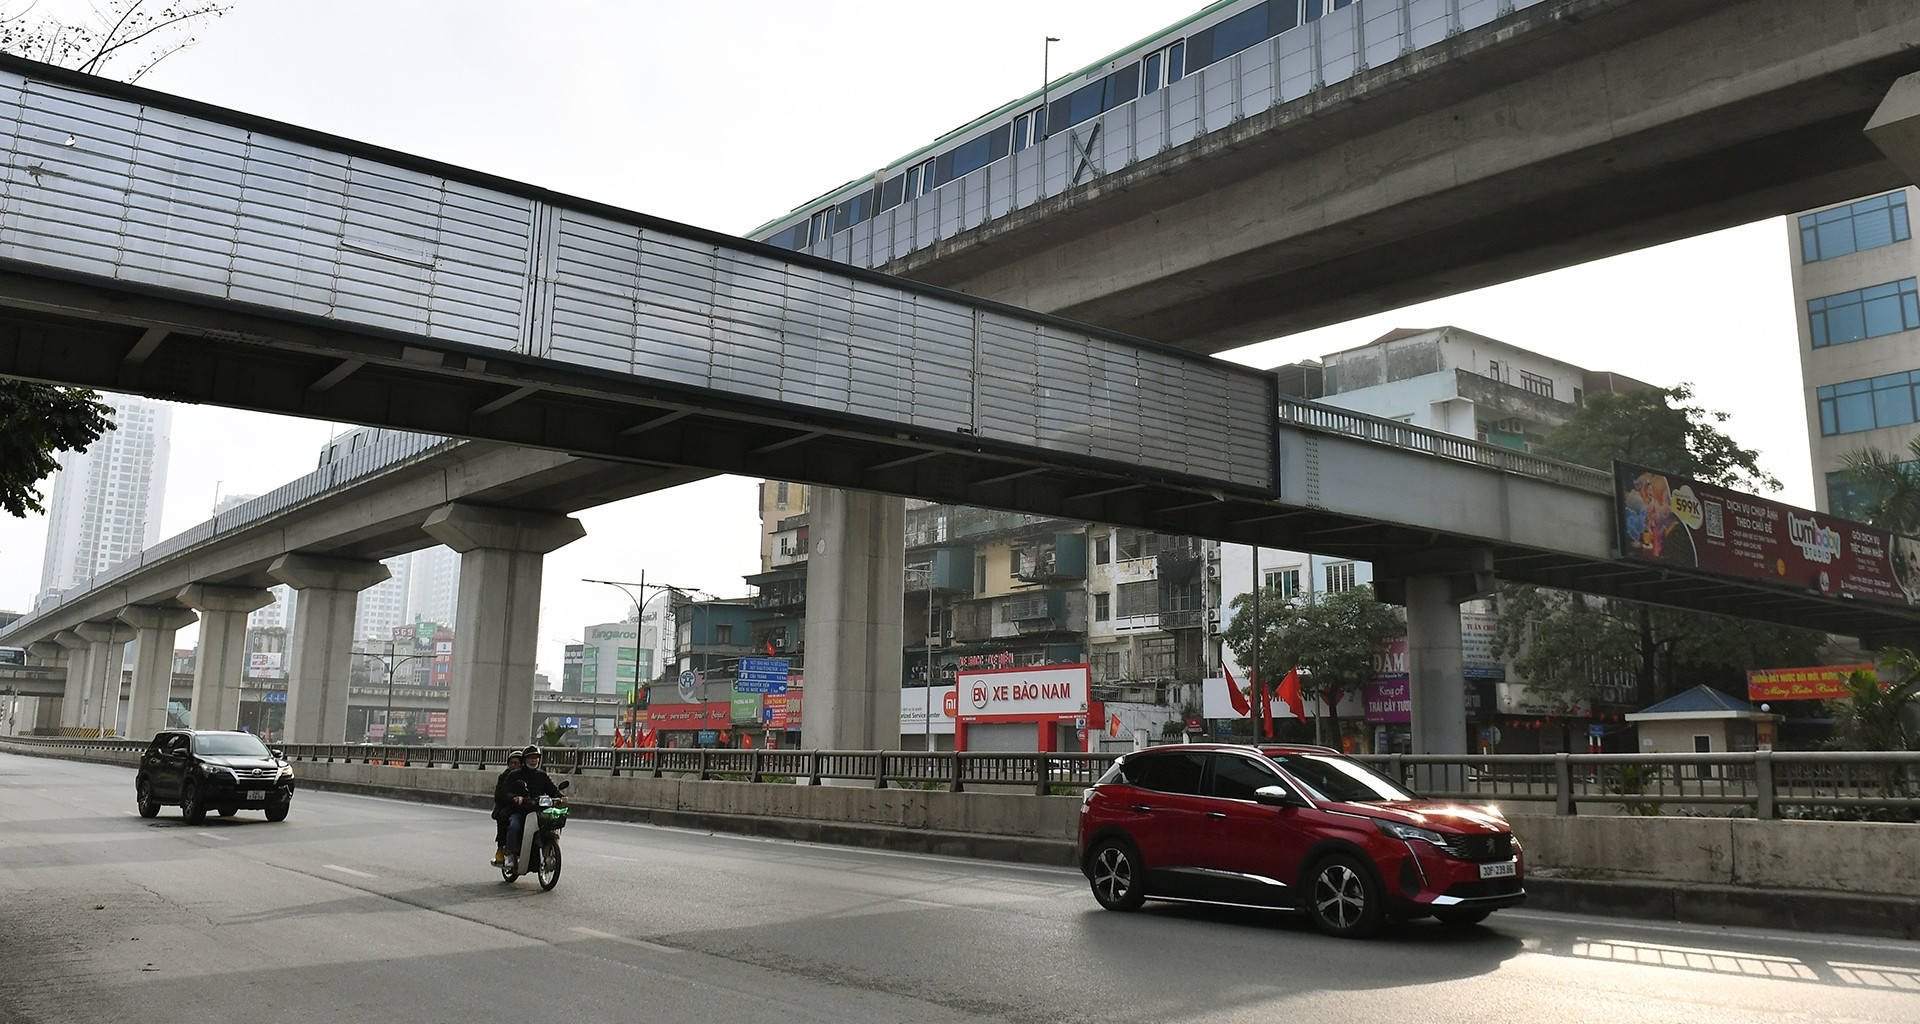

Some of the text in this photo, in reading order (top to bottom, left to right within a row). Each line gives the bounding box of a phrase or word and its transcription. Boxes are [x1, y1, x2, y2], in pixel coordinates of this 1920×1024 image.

[1676, 497, 1700, 515] 599K
[1726, 499, 1741, 514] DỊCH
[1741, 503, 1750, 516] VỤ
[1736, 516, 1751, 529] THEO
[1803, 545, 1832, 564] STUDIO
[394, 627, 413, 636] 369
[592, 628, 637, 640] Kangaroo
[992, 685, 1009, 701] XE
[1042, 682, 1071, 699] NAM
[1379, 685, 1404, 698] King of
[1369, 699, 1384, 712] TRÁI
[1384, 699, 1397, 712] CÂY
[912, 712, 927, 720] Service
